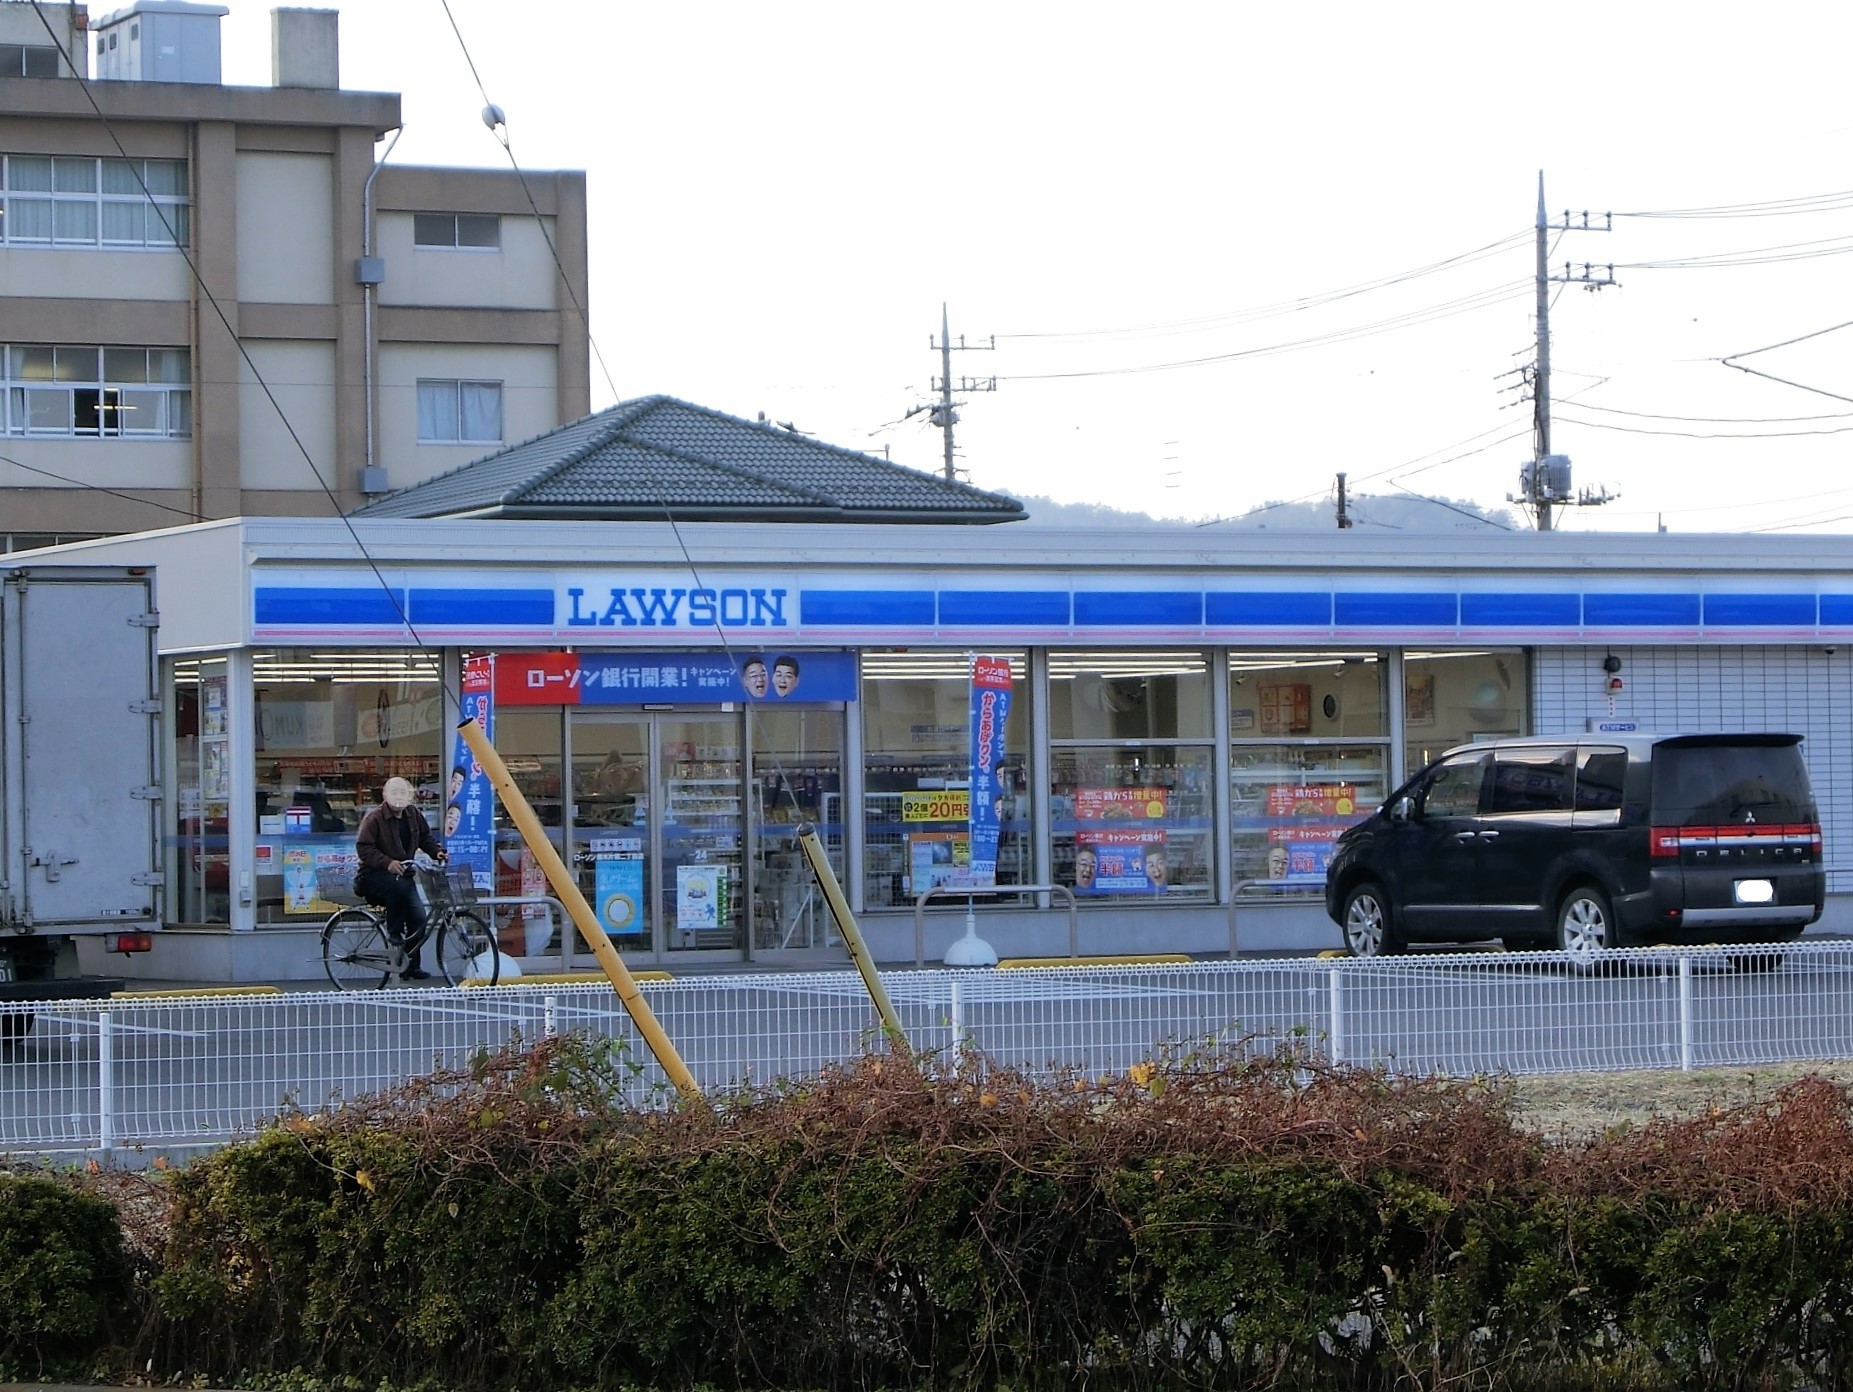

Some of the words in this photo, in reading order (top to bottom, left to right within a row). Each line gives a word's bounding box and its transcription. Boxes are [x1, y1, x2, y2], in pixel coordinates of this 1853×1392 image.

[568, 588, 787, 626] LAWSON
[527, 667, 687, 688] ローソン銀行開業!
[1696, 848, 1802, 857] DELICA
